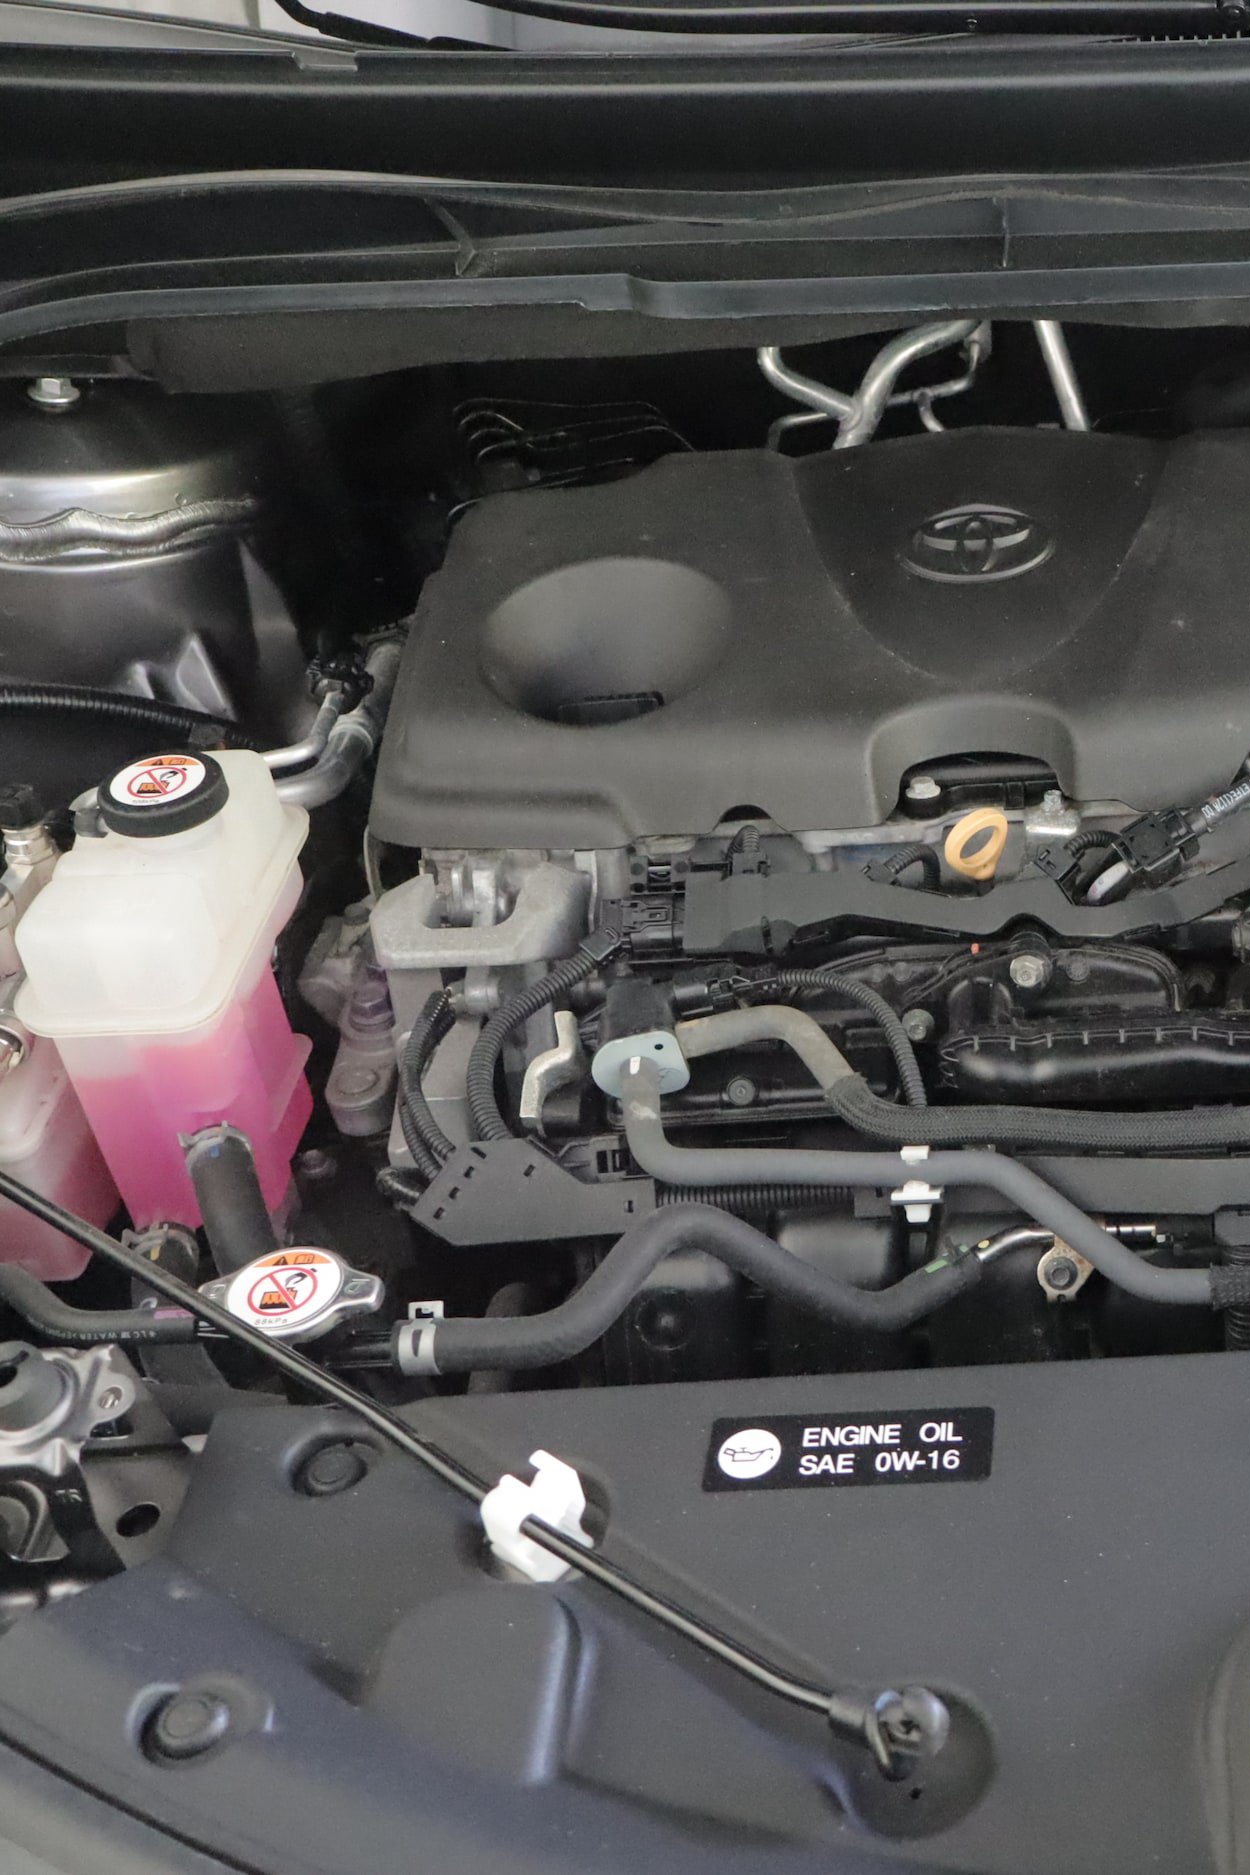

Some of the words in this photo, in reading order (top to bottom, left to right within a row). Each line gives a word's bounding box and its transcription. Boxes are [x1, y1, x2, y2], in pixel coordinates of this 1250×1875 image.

[80, 1331, 117, 1341] WATER
[801, 1423, 902, 1448] ENGINE
[918, 1421, 963, 1443] OIL
[798, 1452, 855, 1476] SAE
[874, 1449, 961, 1473] 0W-16
